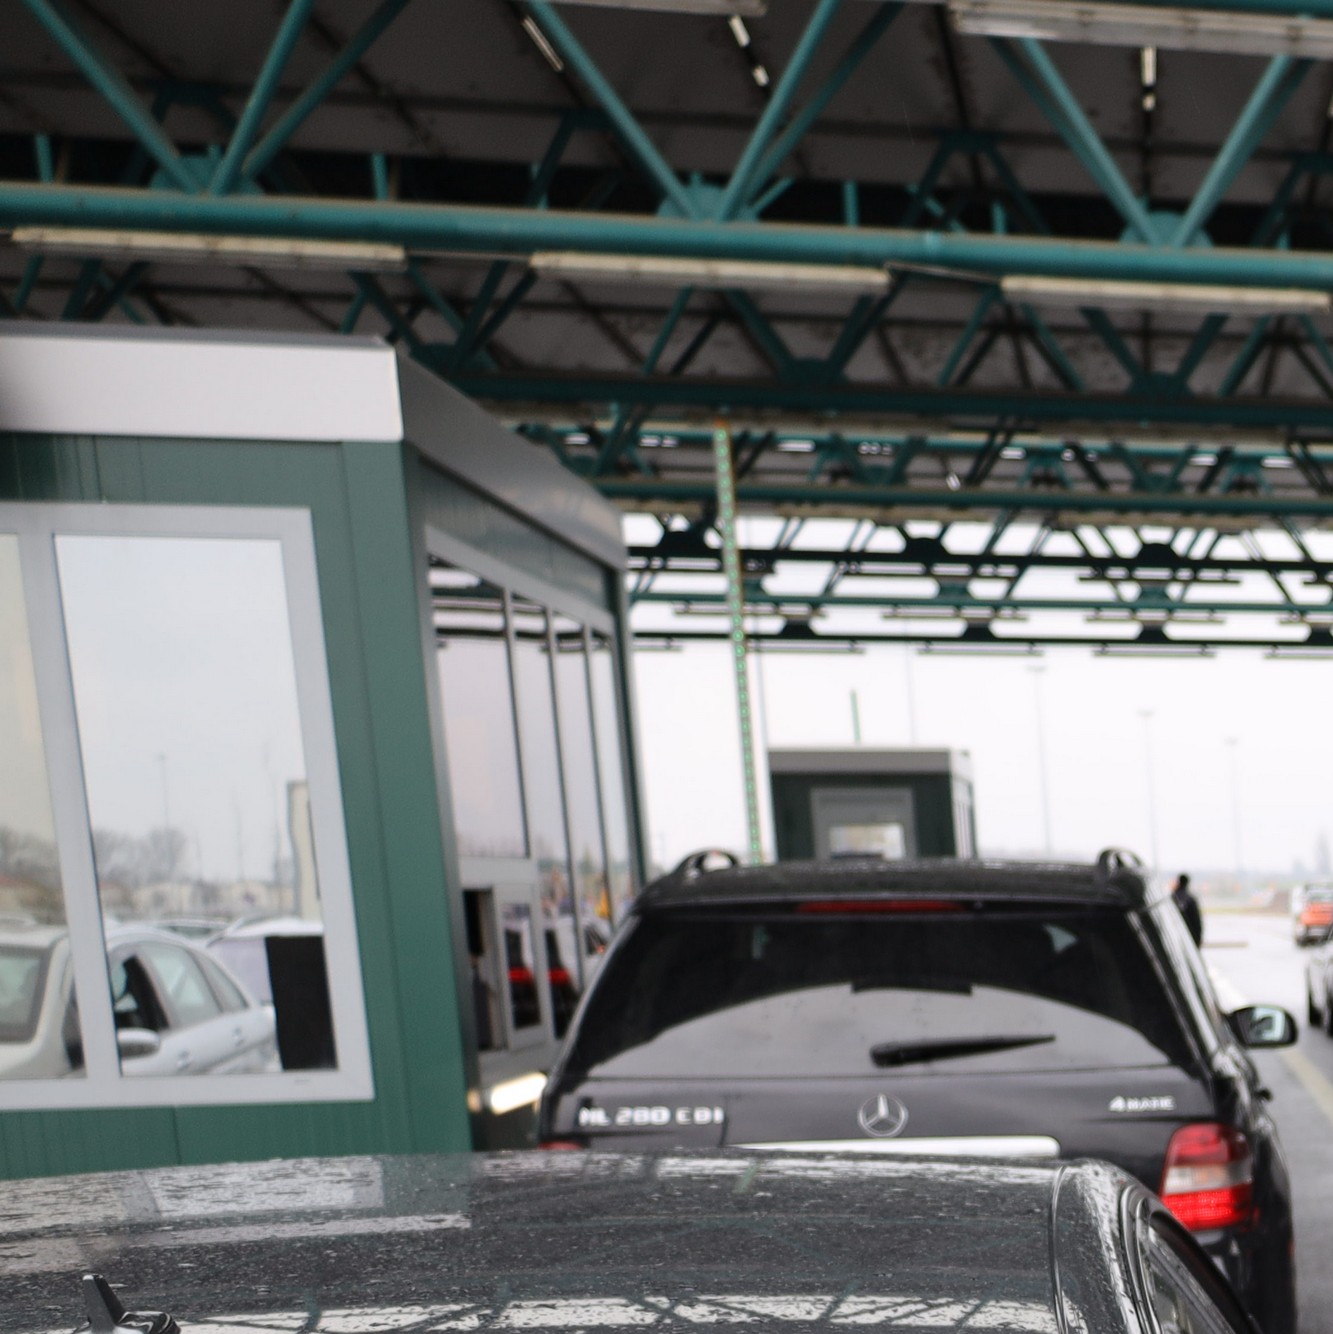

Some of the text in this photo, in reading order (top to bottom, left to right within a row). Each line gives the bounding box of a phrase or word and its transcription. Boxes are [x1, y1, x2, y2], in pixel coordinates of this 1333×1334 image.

[579, 1106, 724, 1126] ML 280 CDI
